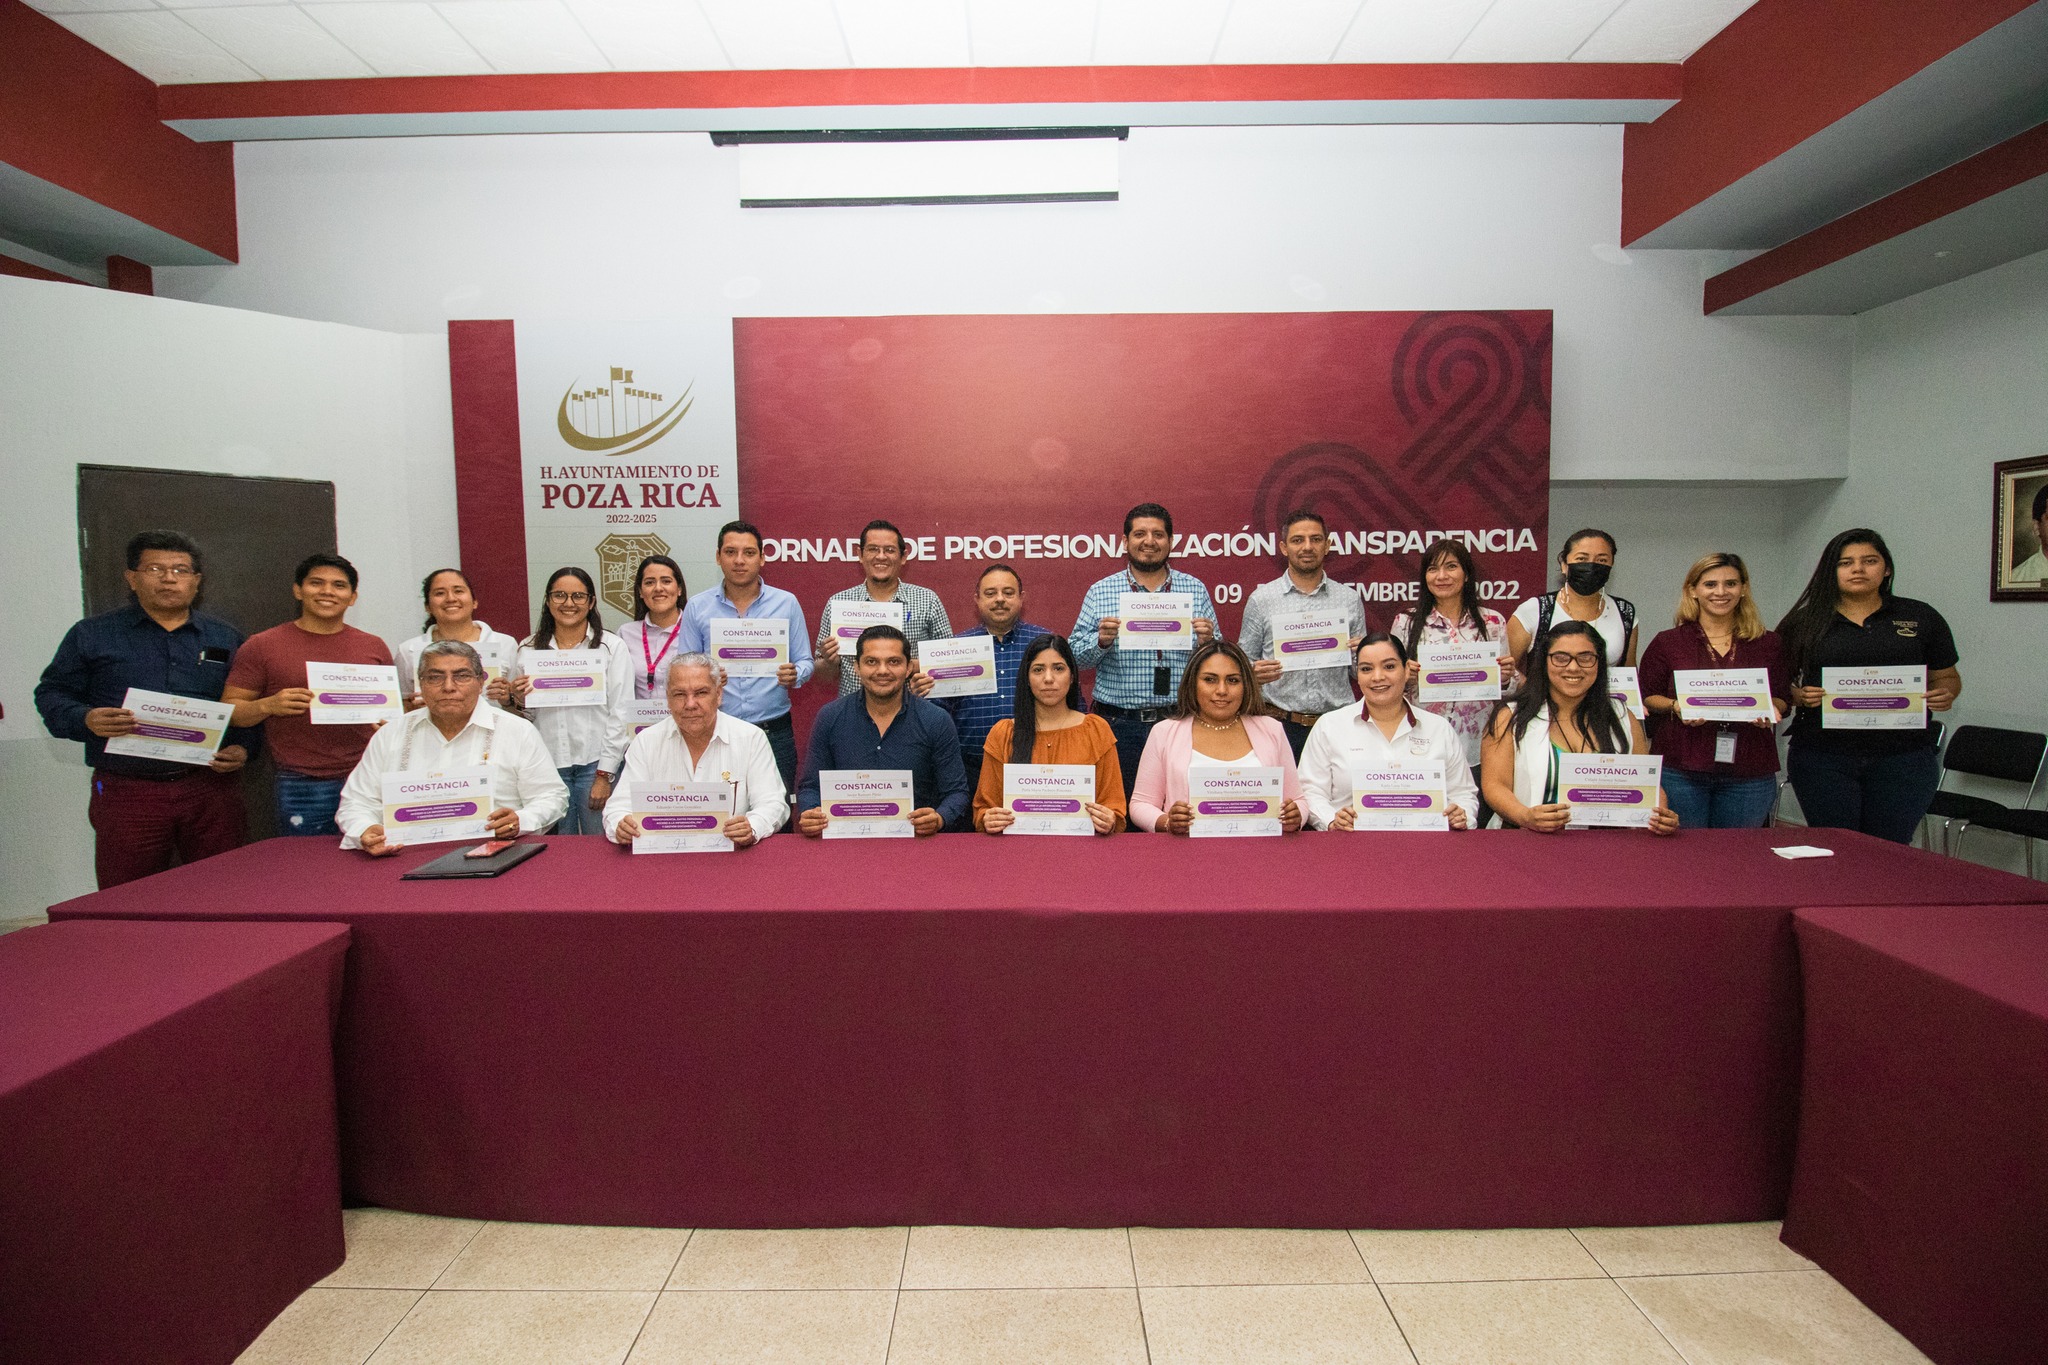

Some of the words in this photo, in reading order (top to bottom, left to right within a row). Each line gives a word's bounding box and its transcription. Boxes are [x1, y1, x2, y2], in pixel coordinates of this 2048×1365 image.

[540, 466, 692, 479] H.AYUNTAMIENTO
[698, 465, 720, 478] DE
[542, 484, 632, 508] POZA
[640, 483, 721, 508] RICA
[606, 514, 657, 524] 2022-2025
[762, 538, 860, 562] ORNAD
[945, 525, 1276, 561] PROFESIONZACIÓN
[1214, 583, 1243, 604] 09
[1284, 620, 1332, 631] CONSTANCIA
[930, 648, 977, 658] CONSTANCIA
[1430, 653, 1482, 662] CONSTANCIA
[322, 674, 380, 682] CONSTANCIA
[141, 704, 208, 720] CONSTANCIA
[1574, 767, 1638, 776] CONSTANCIA
[400, 780, 470, 793] CONSTANCIA
[1018, 777, 1075, 786] CONSTANCIA
[646, 794, 710, 802] CONSTANCIA
